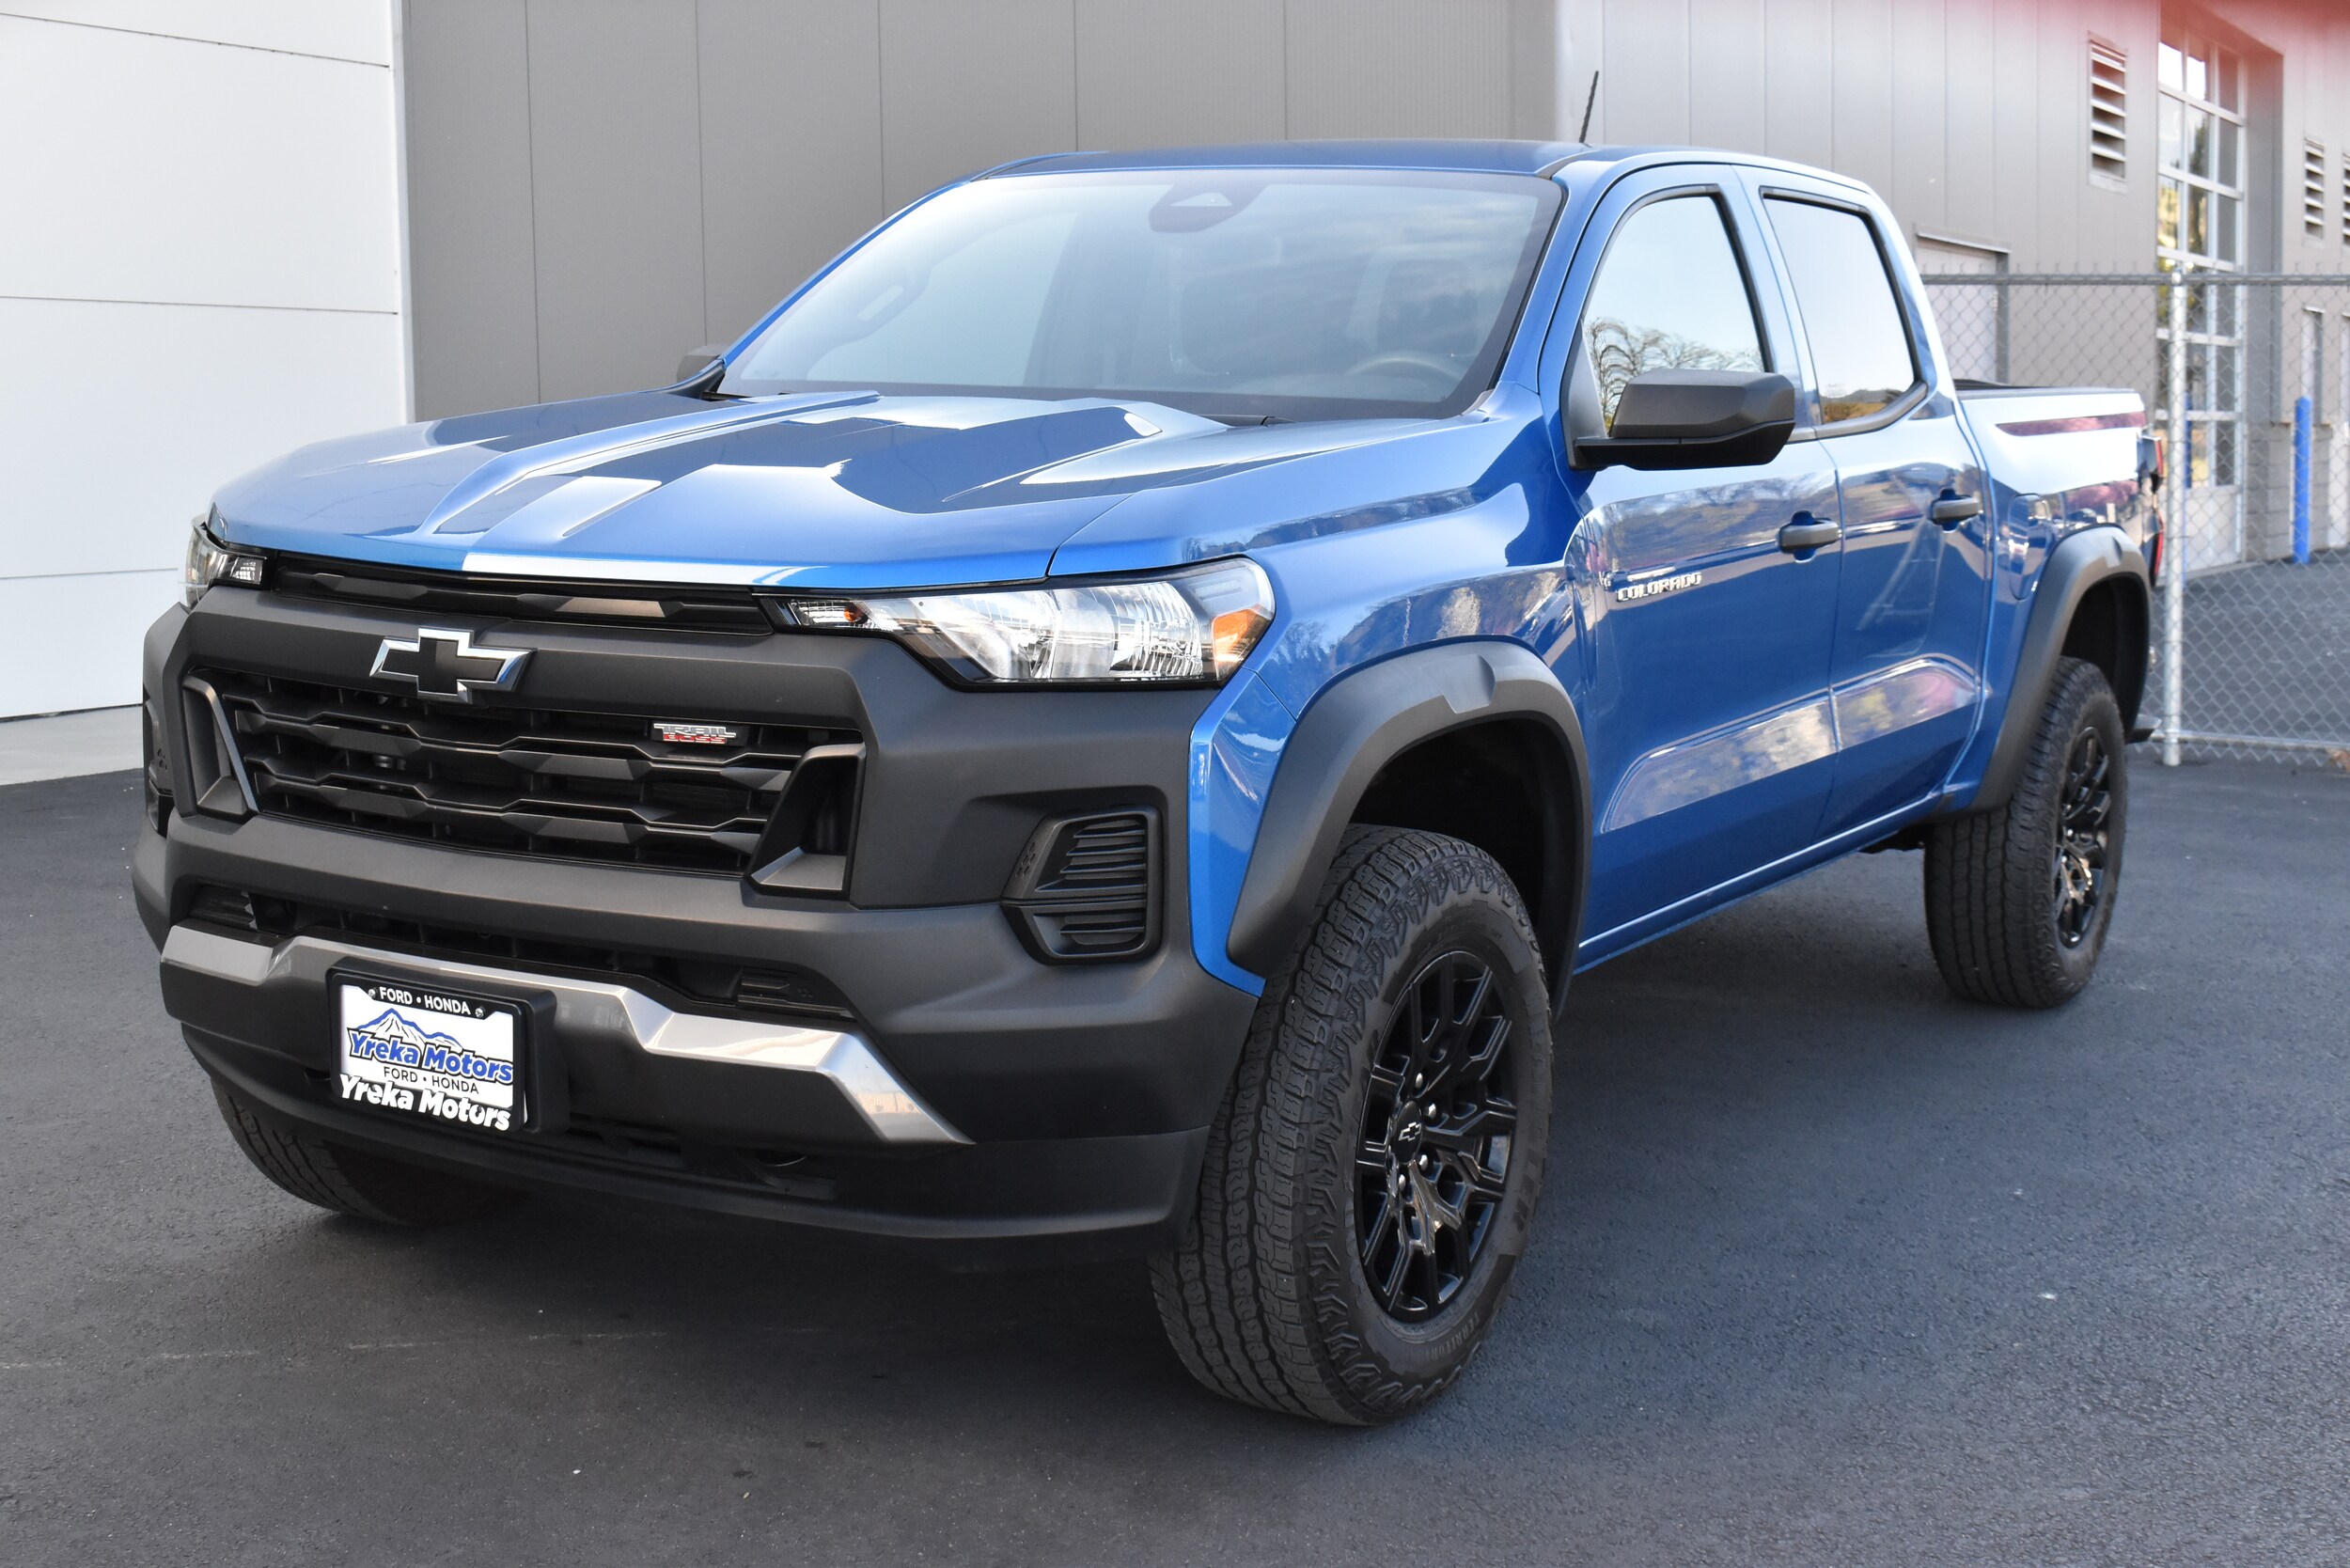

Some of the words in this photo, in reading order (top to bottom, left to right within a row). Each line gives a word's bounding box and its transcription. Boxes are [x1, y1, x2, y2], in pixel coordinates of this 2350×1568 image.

[1617, 572, 1702, 601] COLORADO
[653, 723, 736, 738] TRAIL
[379, 986, 413, 1004] FORD
[424, 995, 471, 1015] HONDA
[350, 1030, 420, 1066] Yreka
[423, 1045, 513, 1083] Motors
[384, 1066, 418, 1083] FORD
[431, 1075, 479, 1094] HONDA
[339, 1074, 415, 1110] Yreka
[418, 1088, 511, 1131] Motors
